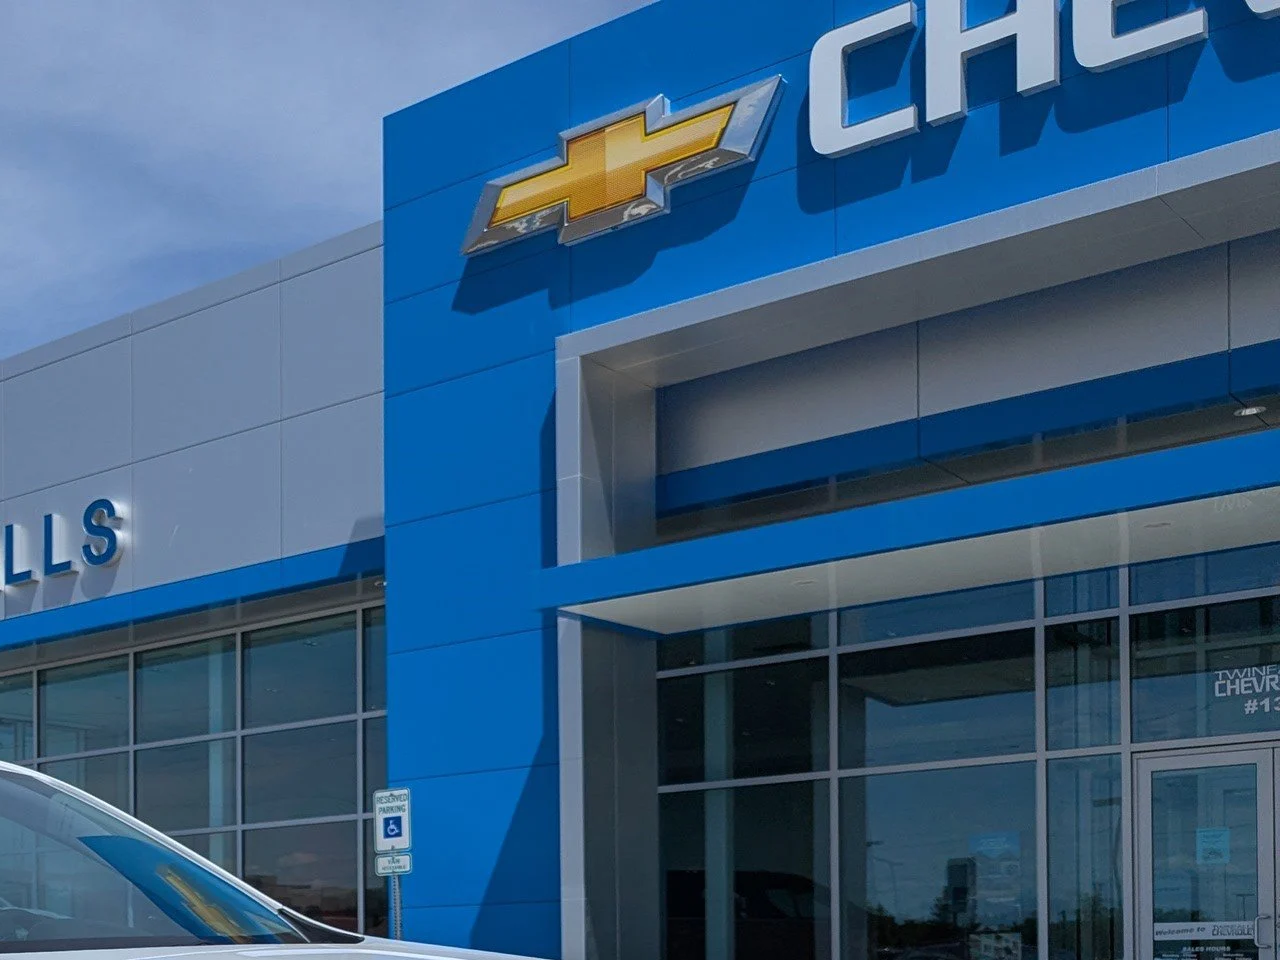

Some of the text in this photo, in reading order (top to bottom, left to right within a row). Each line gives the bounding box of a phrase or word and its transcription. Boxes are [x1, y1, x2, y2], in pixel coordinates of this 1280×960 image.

[1214, 664, 1280, 680] TWINF
[376, 793, 408, 804] RESERVED
[378, 805, 406, 815] PARKING
[1155, 927, 1195, 936] Welcome
